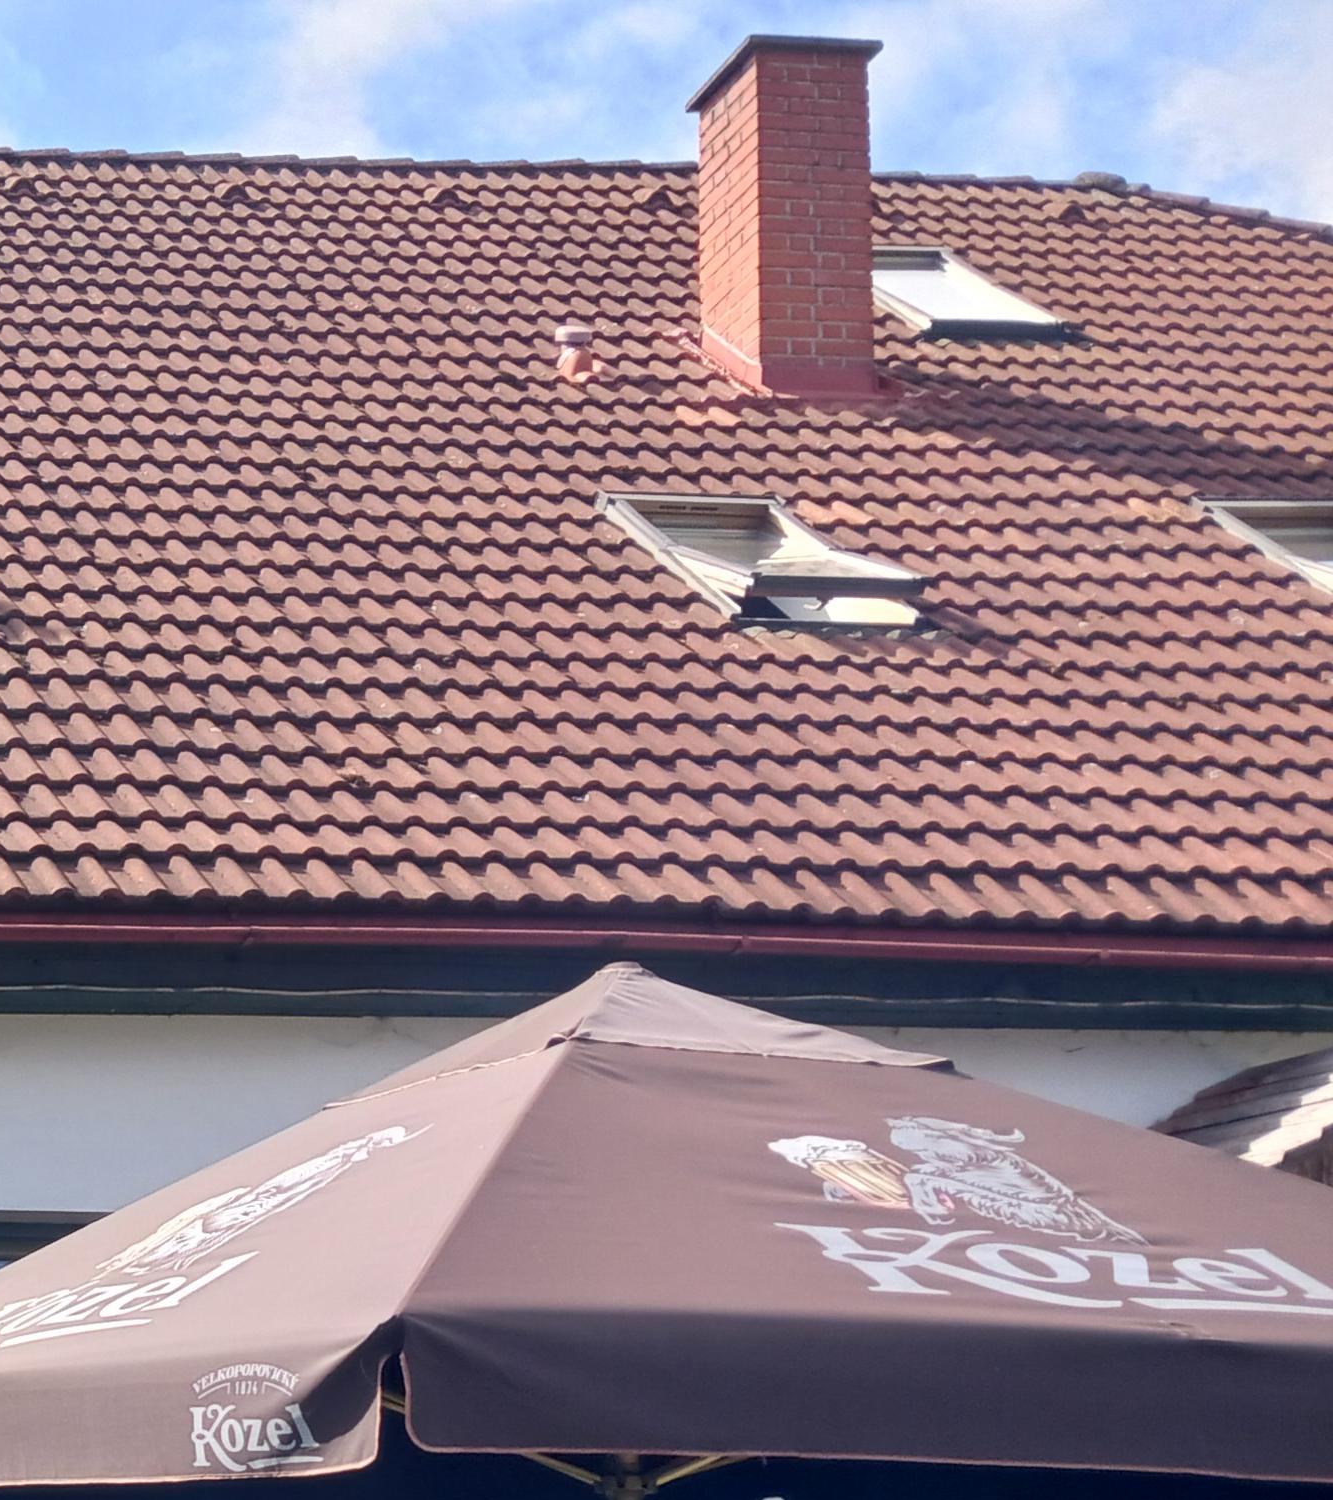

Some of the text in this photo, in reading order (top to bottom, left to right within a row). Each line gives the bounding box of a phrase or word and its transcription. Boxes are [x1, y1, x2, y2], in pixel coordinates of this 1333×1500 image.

[773, 1222, 1333, 1309] Kozel
[192, 1362, 300, 1394] VELKOPOPOVICKÝ
[189, 1402, 321, 1472] Kozel
